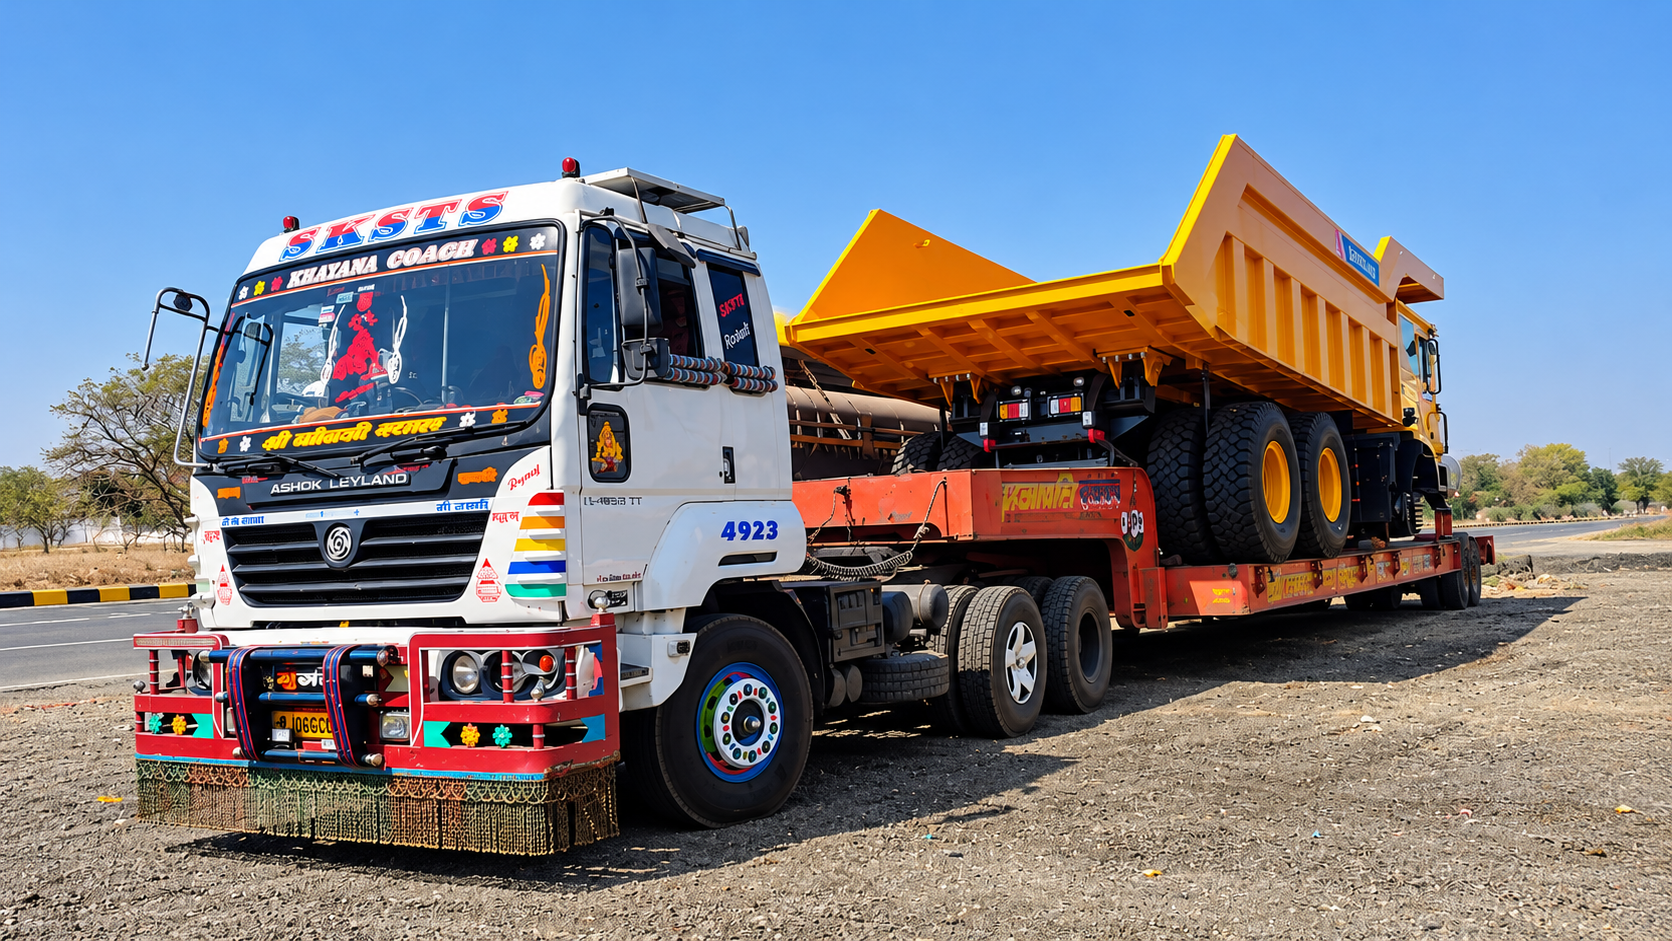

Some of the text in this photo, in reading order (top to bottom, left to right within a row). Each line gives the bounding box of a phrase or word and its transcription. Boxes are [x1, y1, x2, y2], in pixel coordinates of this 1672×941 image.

[279, 190, 509, 262] SKSTS
[286, 239, 479, 289] KHAYANA COACH
[271, 479, 322, 495] ASHOK
[330, 473, 408, 489] LEYLAND
[721, 520, 779, 541] 4923
